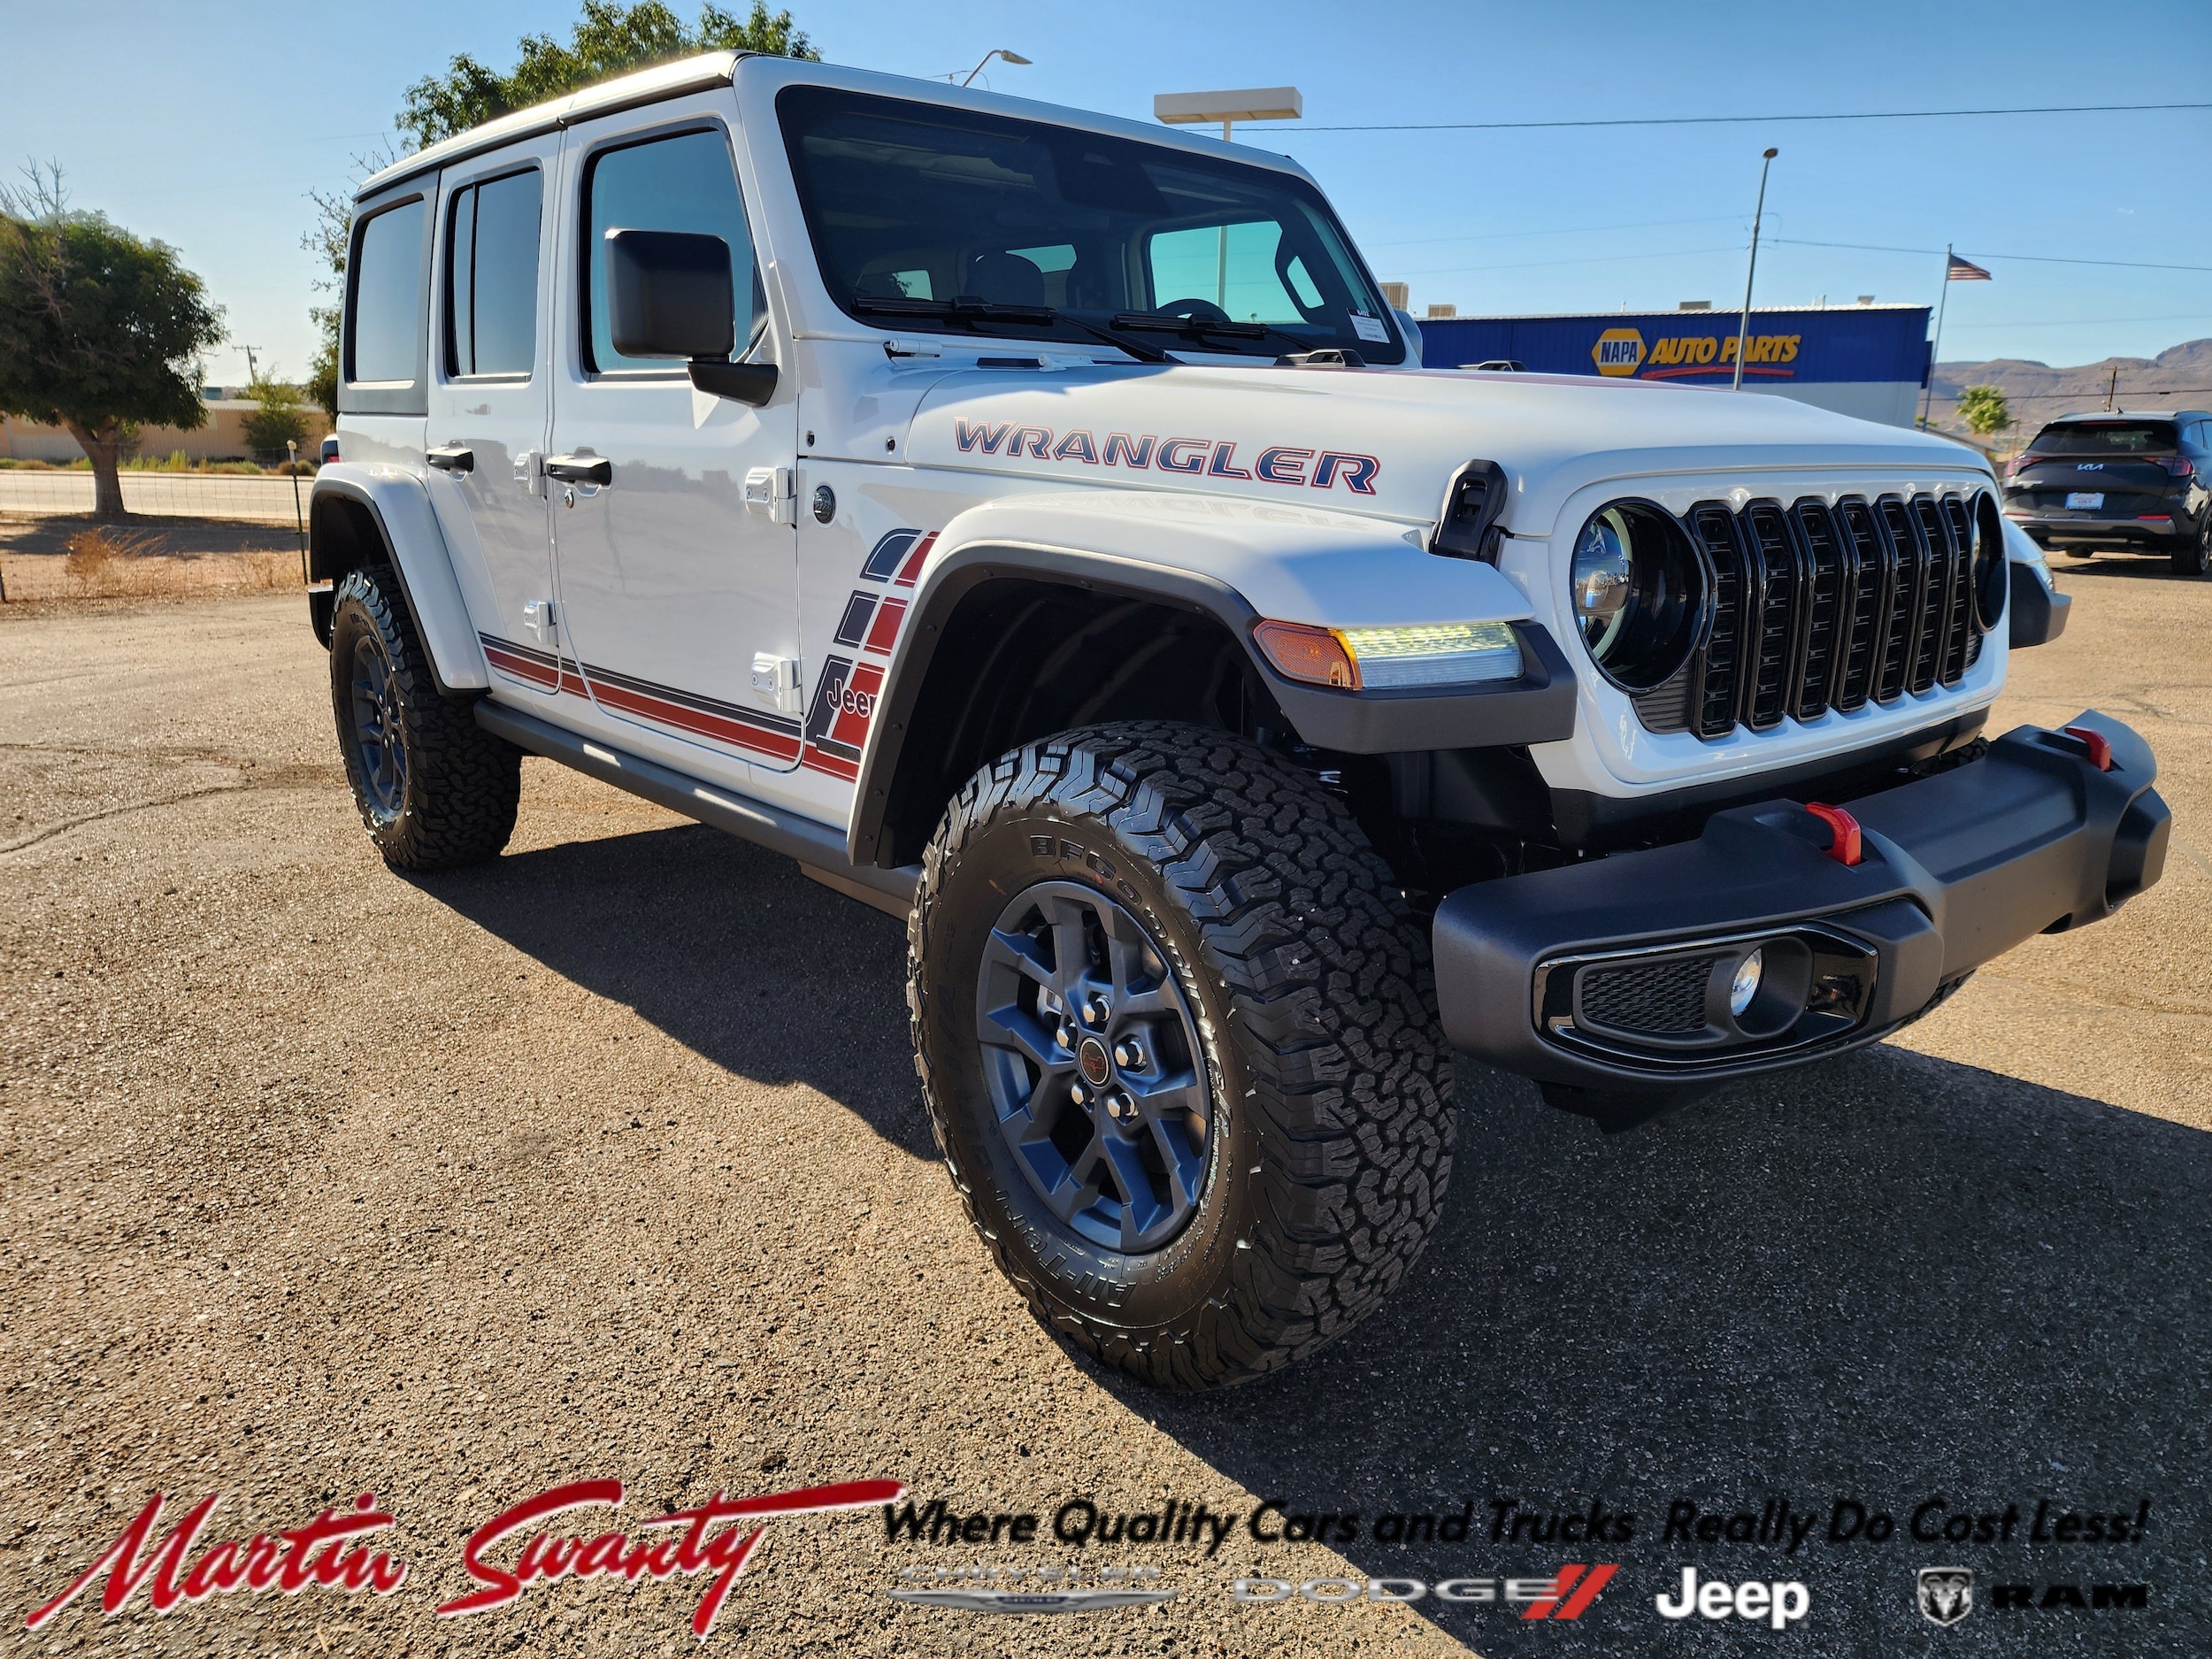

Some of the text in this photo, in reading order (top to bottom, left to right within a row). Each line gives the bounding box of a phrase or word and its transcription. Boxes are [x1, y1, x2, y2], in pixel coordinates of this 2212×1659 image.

[1600, 335, 1802, 365] NAPA AUTO PARTS
[954, 416, 1381, 495] WRANGLER
